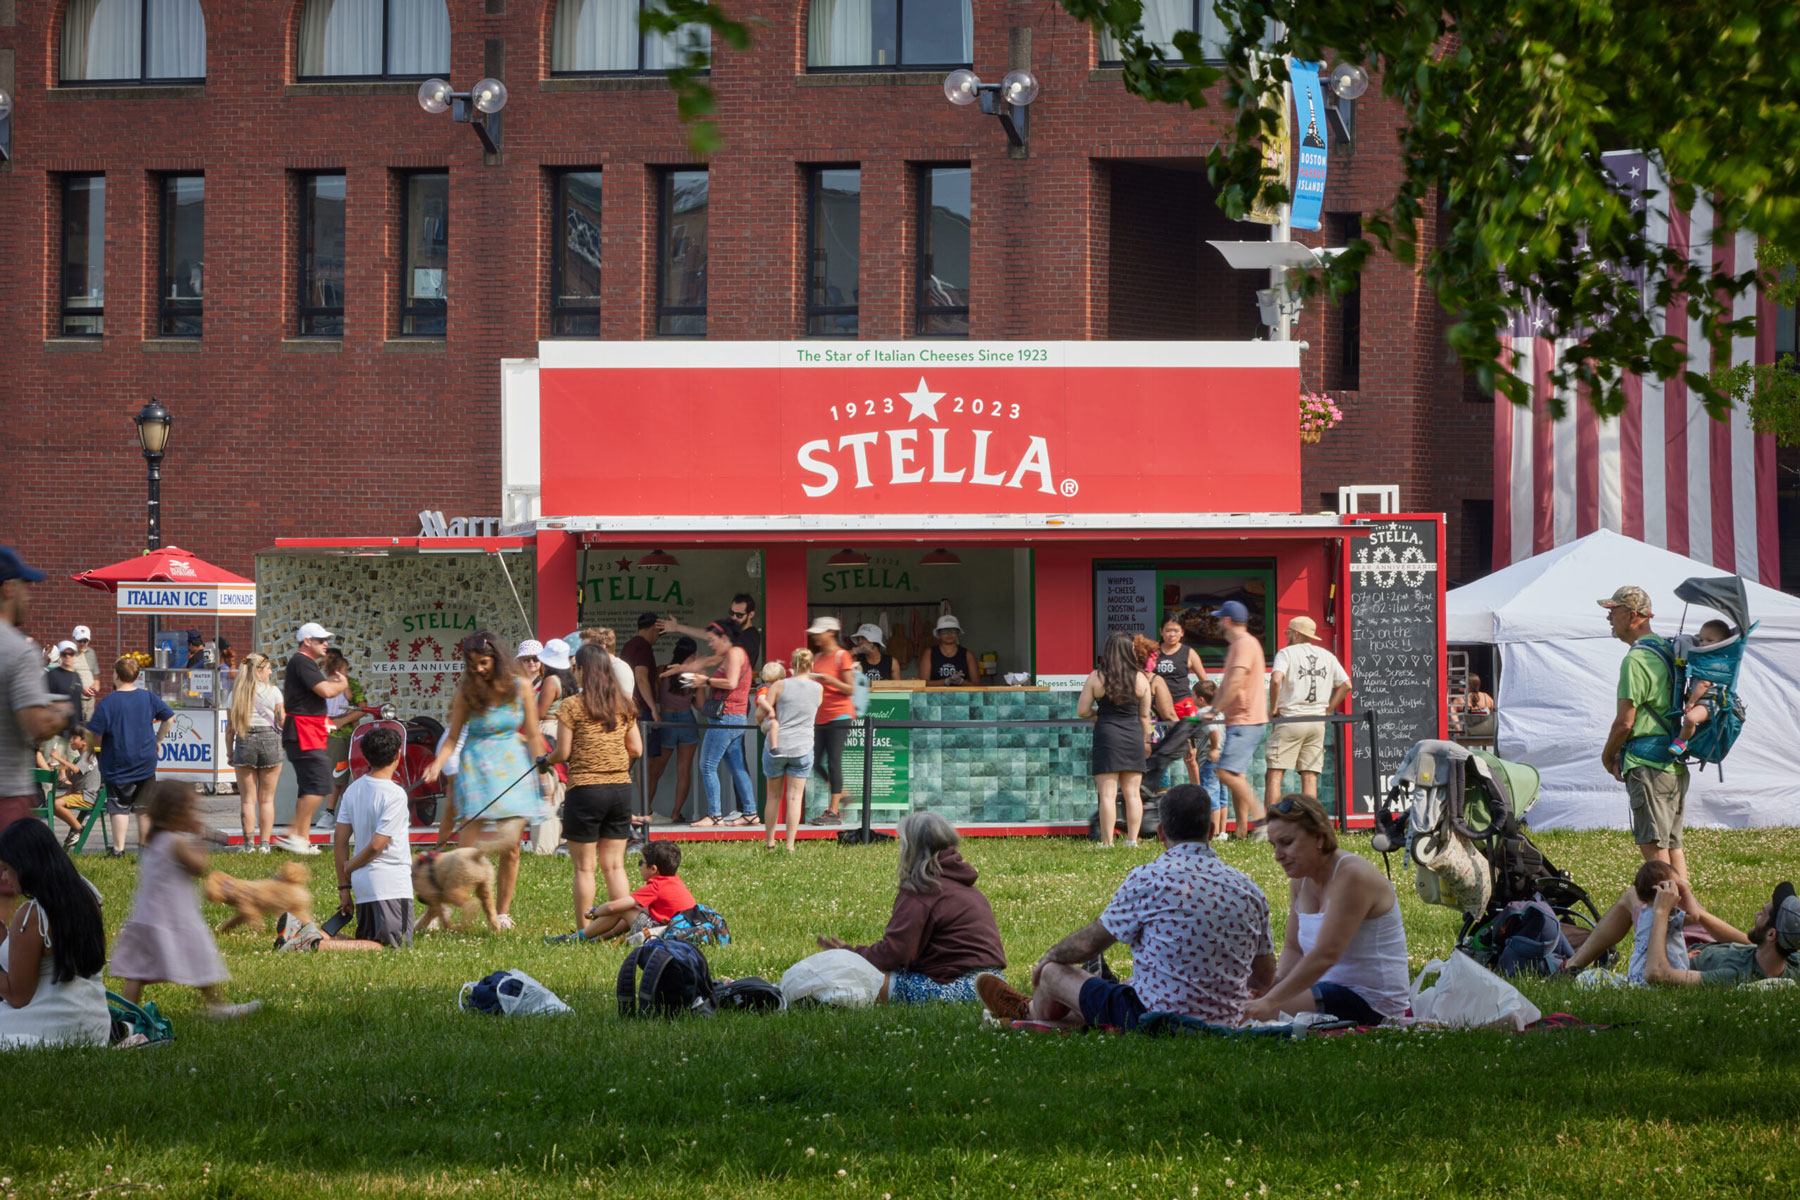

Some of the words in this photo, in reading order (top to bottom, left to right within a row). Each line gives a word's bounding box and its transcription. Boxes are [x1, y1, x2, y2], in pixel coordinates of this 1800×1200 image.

[1301, 153, 1326, 166] BOSTON
[1300, 167, 1325, 179] HARBOR
[1298, 180, 1324, 192] ISLANDS
[797, 350, 821, 362] The
[825, 350, 852, 362] Star
[856, 349, 870, 362] of
[874, 349, 915, 362] Italian
[919, 349, 974, 362] Cheeses
[978, 350, 1014, 362] Since
[1018, 349, 1048, 362] 1923
[830, 398, 894, 421] 1923
[953, 397, 1021, 419] 2023
[418, 510, 502, 538] Marr
[590, 562, 612, 572] 923
[1357, 546, 1426, 588] 100
[822, 568, 911, 592] STELLA
[1107, 577, 1134, 585] WHIPPED
[127, 591, 180, 606] ITALIAN
[184, 592, 208, 606] ICE
[220, 594, 253, 605] LEMONADE
[403, 612, 477, 633] STELLA
[374, 663, 405, 672] YEAR
[412, 663, 466, 672] ANNIVER
[158, 743, 212, 762] ONADE
